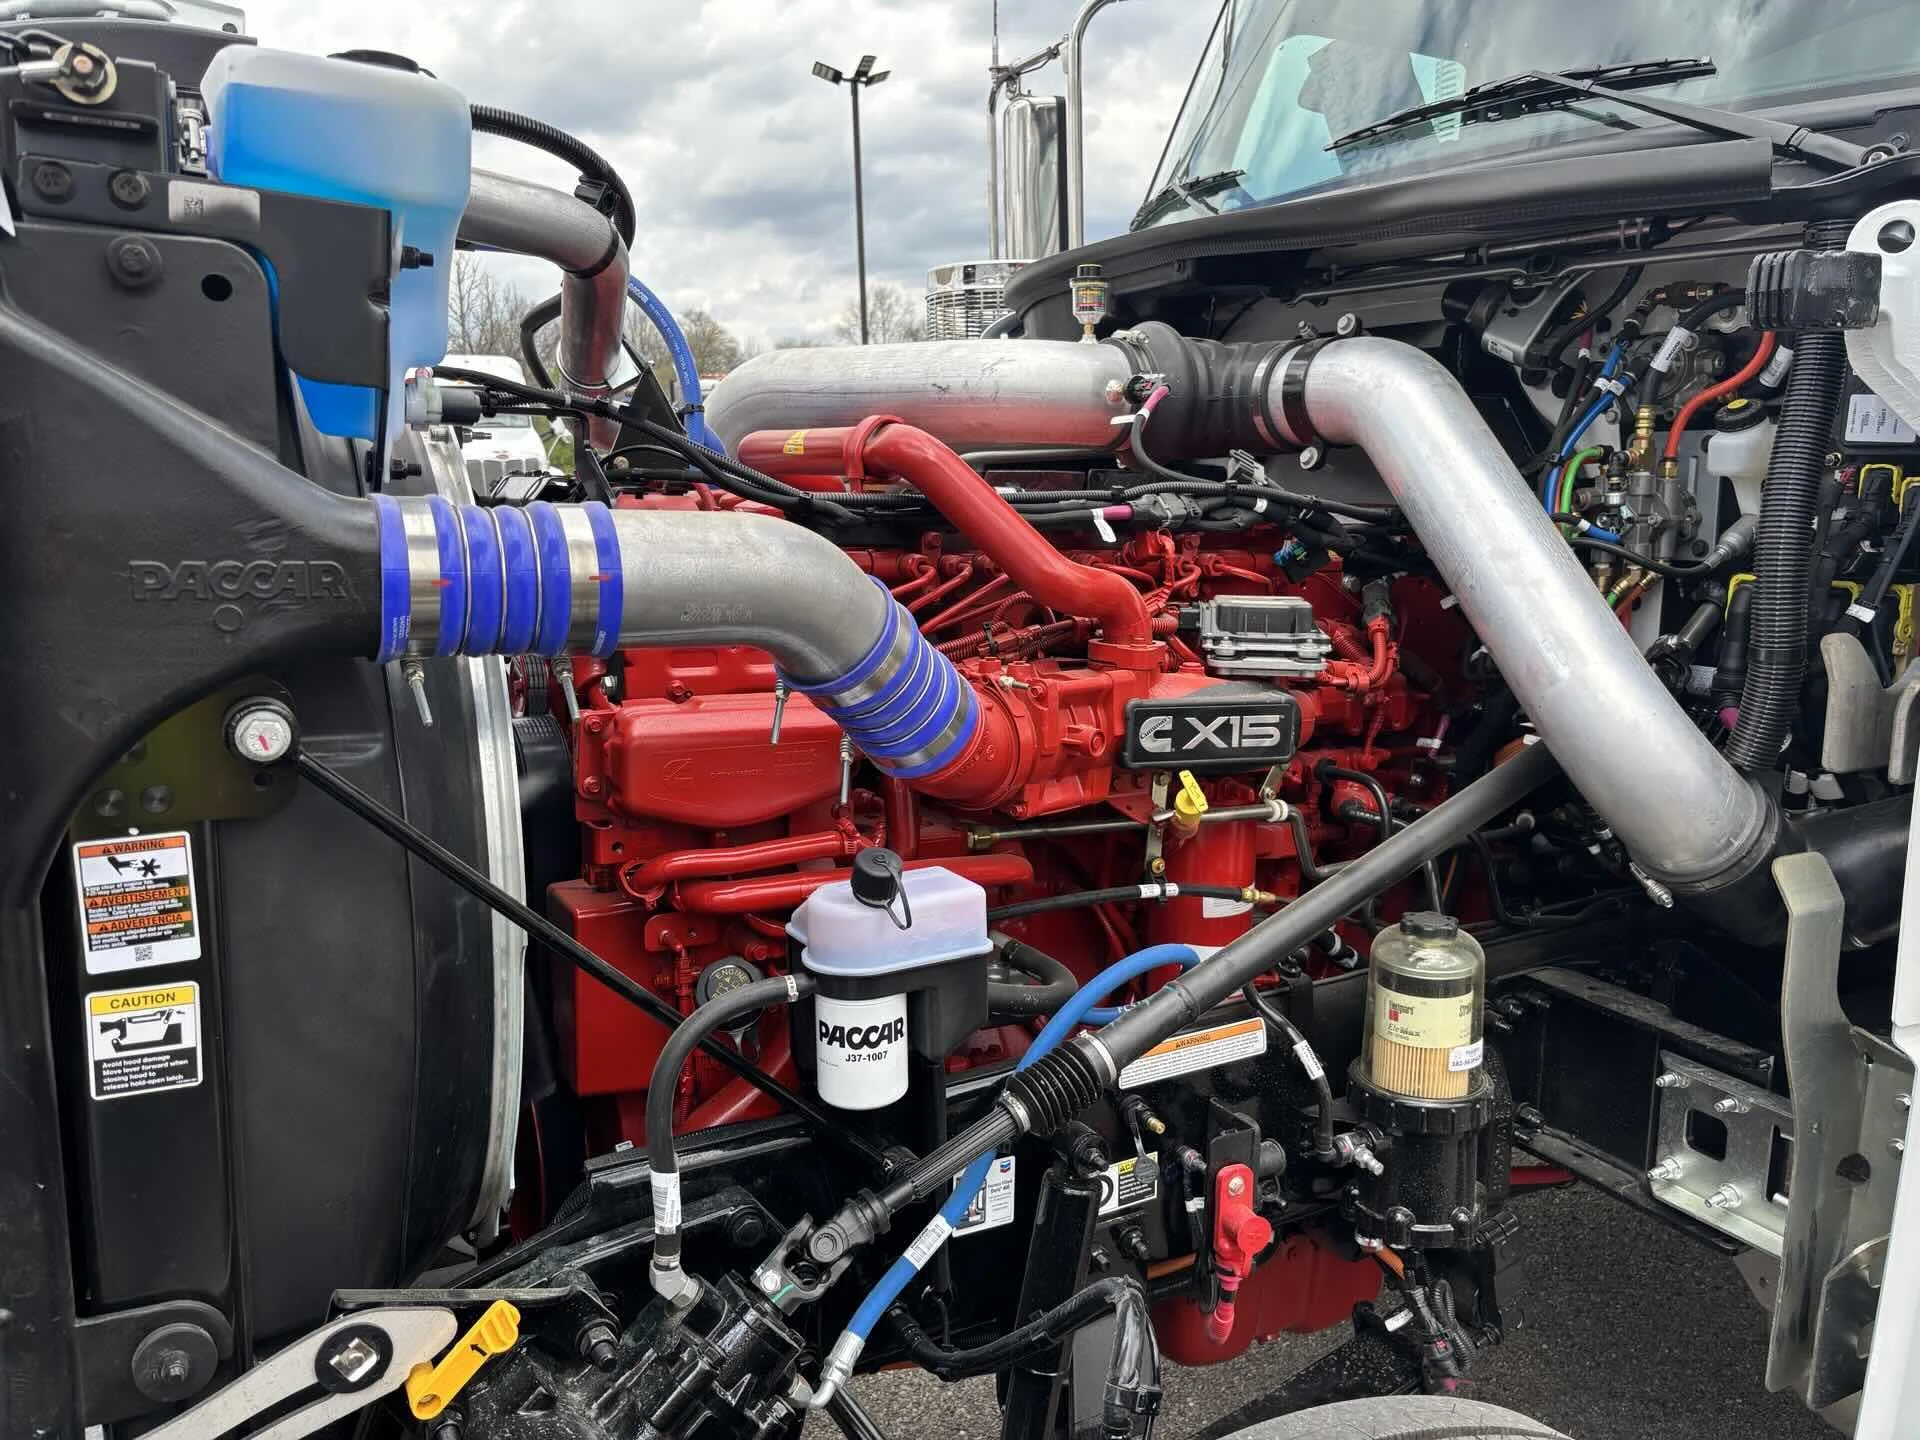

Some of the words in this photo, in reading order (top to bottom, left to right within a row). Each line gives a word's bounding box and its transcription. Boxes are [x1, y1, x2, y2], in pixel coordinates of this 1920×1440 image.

[129, 559, 347, 601] PACCAR
[1182, 715, 1281, 749] X15
[114, 839, 165, 853] WARNING
[101, 887, 187, 907] AVERTISSEMENT
[111, 914, 183, 930] ADVERTENCIA
[716, 968, 747, 983] ENGINE
[110, 992, 176, 1009] CAUTION
[818, 1016, 904, 1050] PACCAR
[1180, 1034, 1211, 1048] WARNING
[845, 1050, 888, 1063] J37-1007
